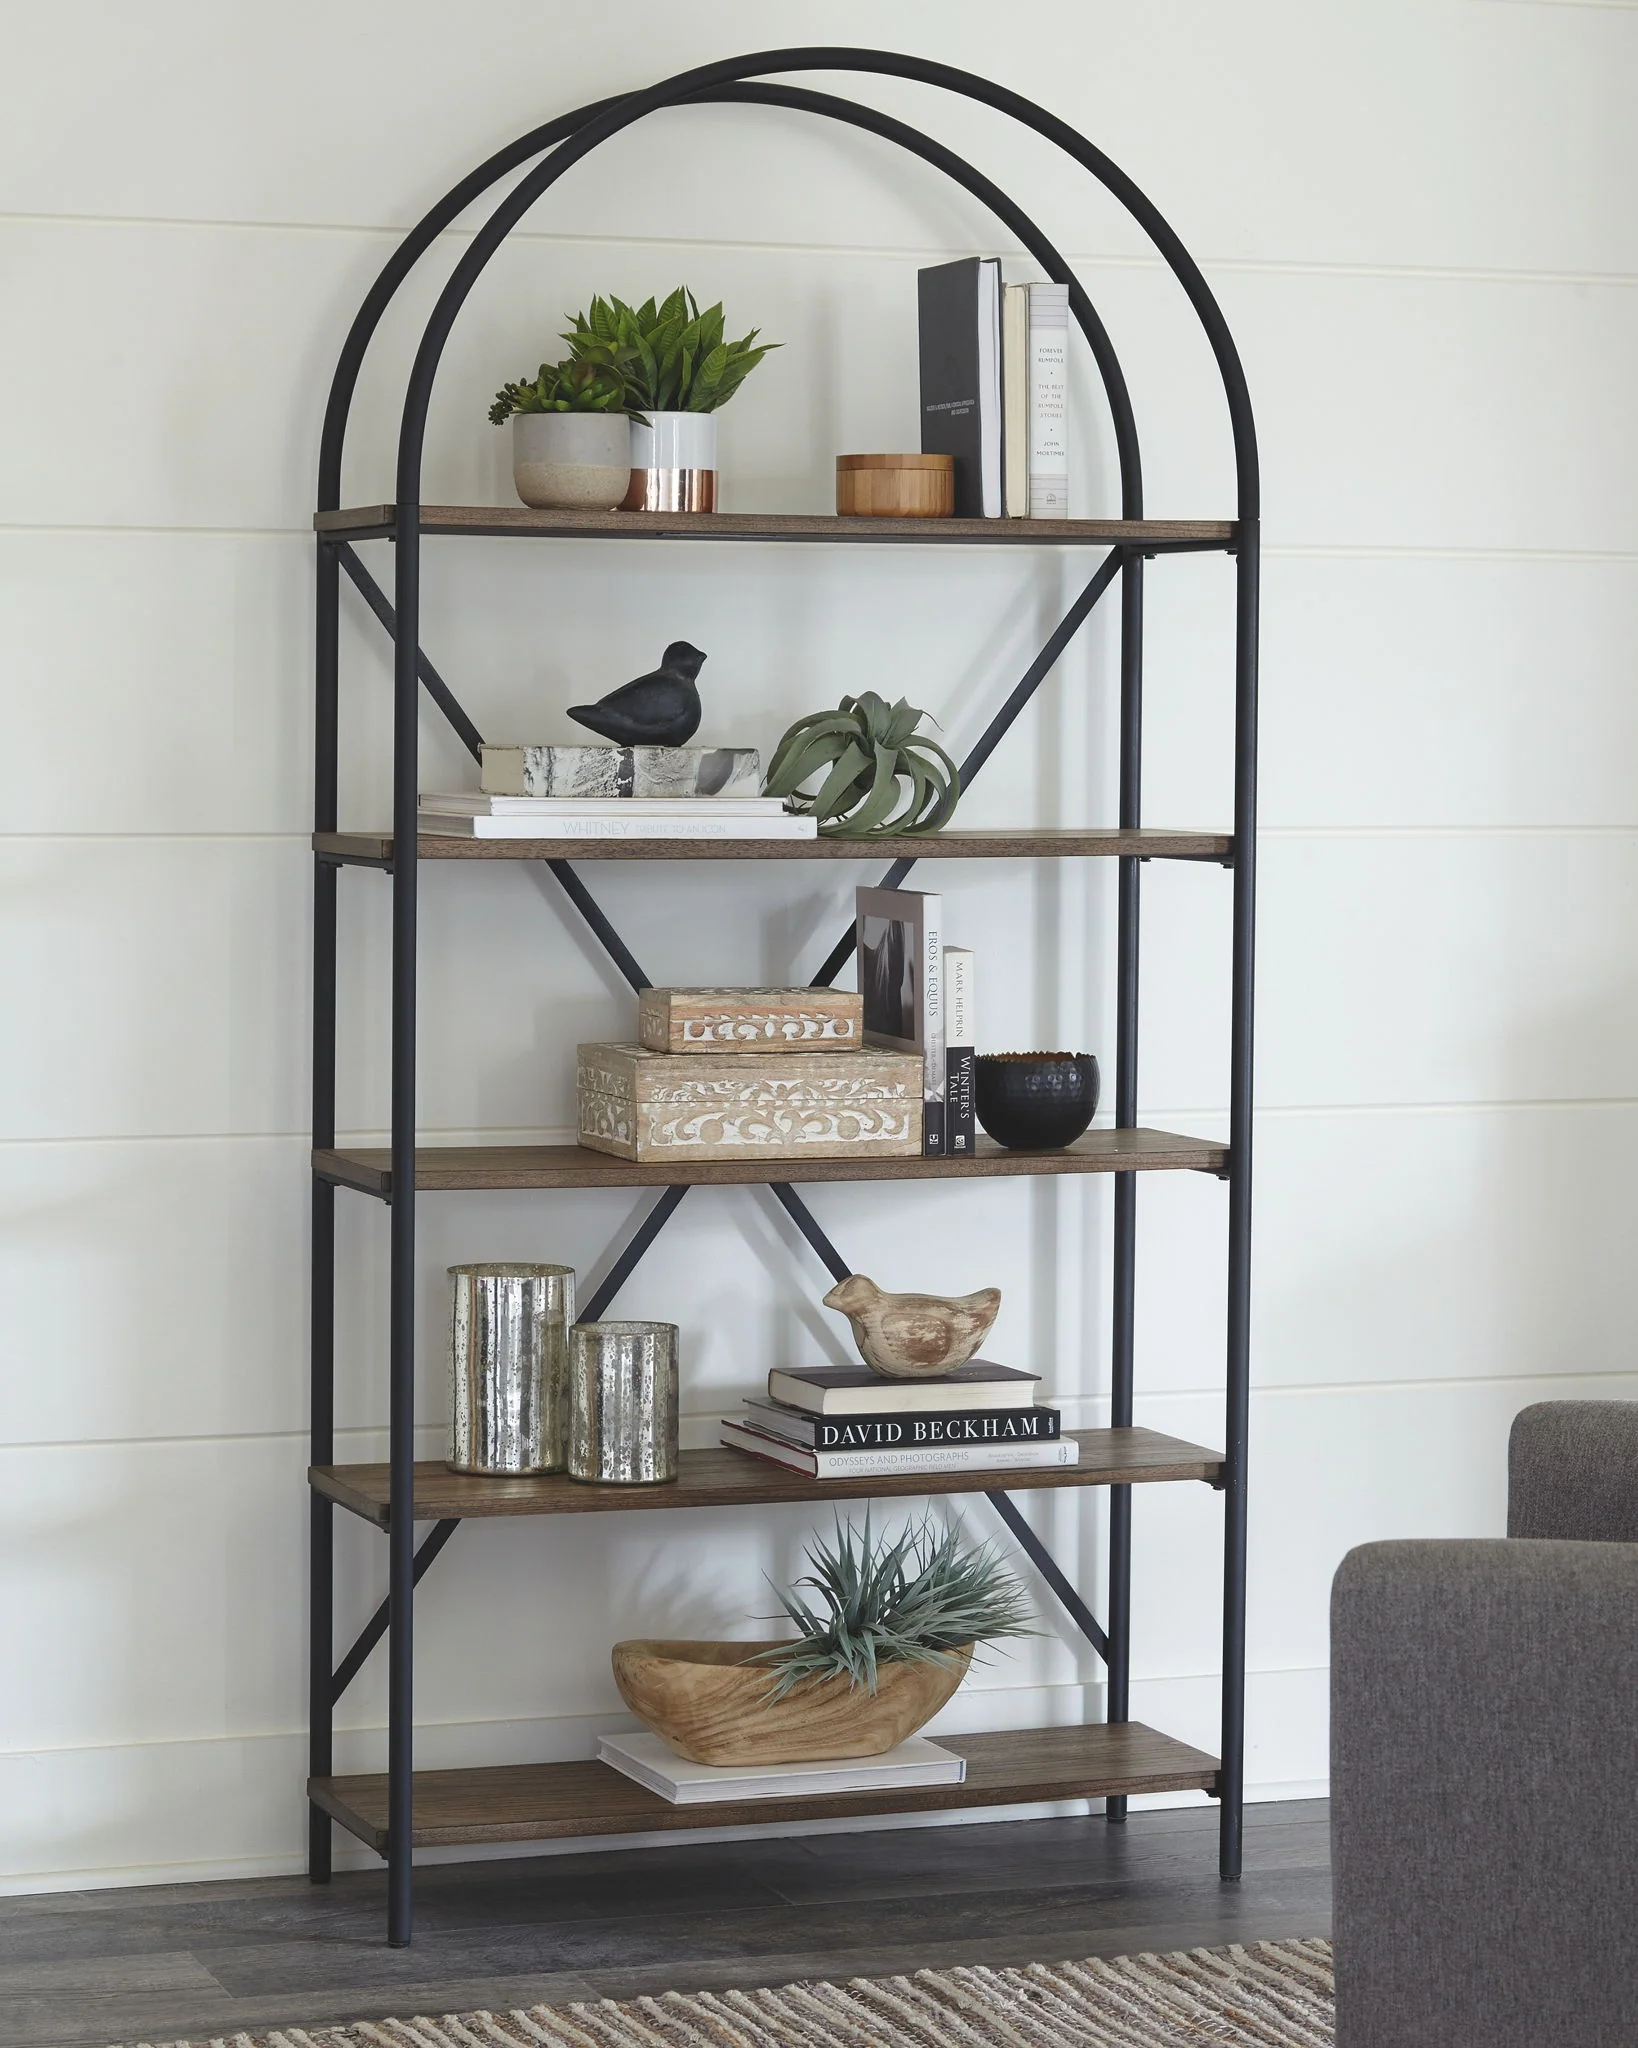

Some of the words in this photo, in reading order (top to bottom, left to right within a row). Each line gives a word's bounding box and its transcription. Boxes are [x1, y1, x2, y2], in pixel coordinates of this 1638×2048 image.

[562, 821, 631, 836] WHITNEY
[928, 931, 938, 961] EROS
[928, 964, 938, 974] &
[955, 961, 964, 993] MARK
[926, 977, 938, 1017] EQUUS
[955, 997, 964, 1038] HELPRIN
[949, 1072, 960, 1103] TALE
[960, 1055, 971, 1119] WINTER'S
[822, 1423, 903, 1445] DAVID
[912, 1416, 1040, 1441] BECKHAM
[829, 1455, 875, 1467] ODYSSEYS
[876, 1454, 898, 1465] AND
[900, 1451, 970, 1464] PHOTOGRAPHS
